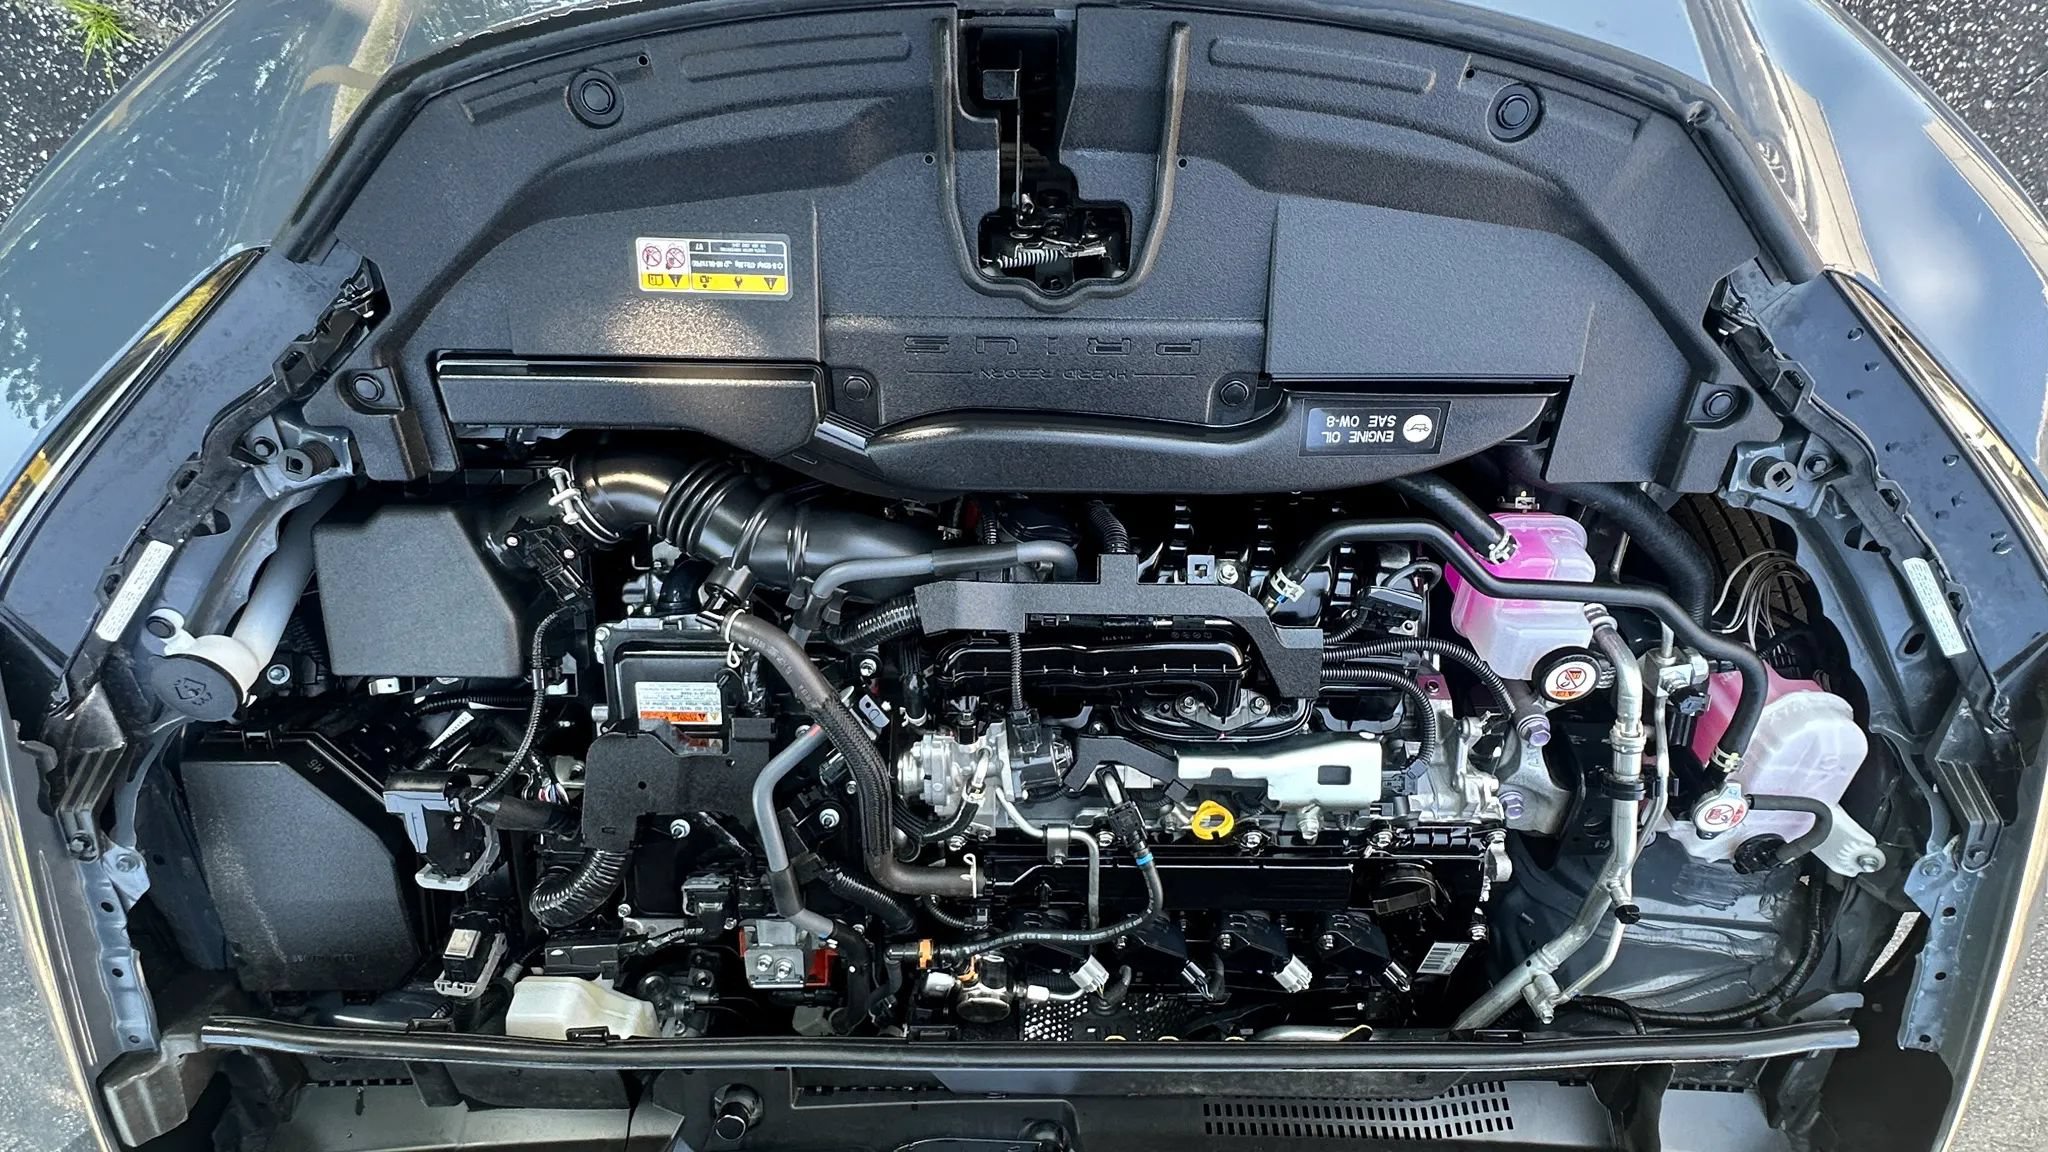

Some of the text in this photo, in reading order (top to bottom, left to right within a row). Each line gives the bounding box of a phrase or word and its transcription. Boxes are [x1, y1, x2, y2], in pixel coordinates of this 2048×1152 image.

[904, 335, 1201, 357] PRIUS
[980, 367, 1129, 382] HYBRID REBORN
[1326, 415, 1397, 428] SAE 0W-8
[1321, 430, 1395, 443] ENGINE OIL
